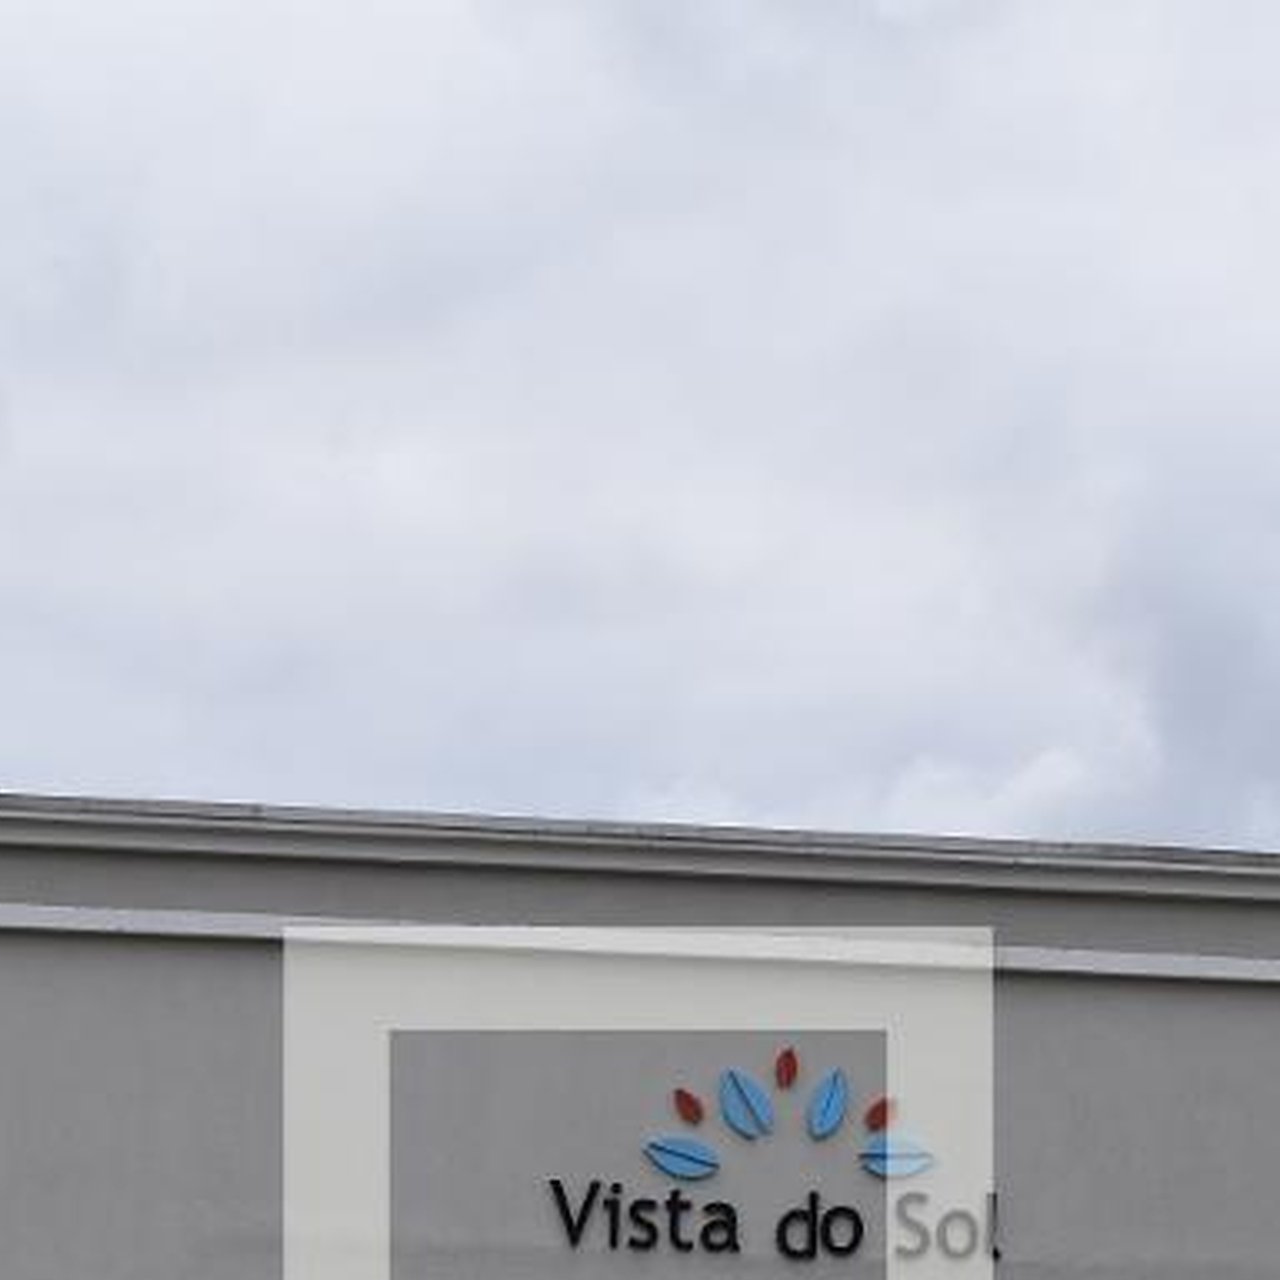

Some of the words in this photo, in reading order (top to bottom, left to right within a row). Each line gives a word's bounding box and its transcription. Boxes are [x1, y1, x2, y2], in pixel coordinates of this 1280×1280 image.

[549, 1179, 740, 1254] Vista
[775, 1191, 864, 1260] do
[895, 1192, 1002, 1261] Sol
